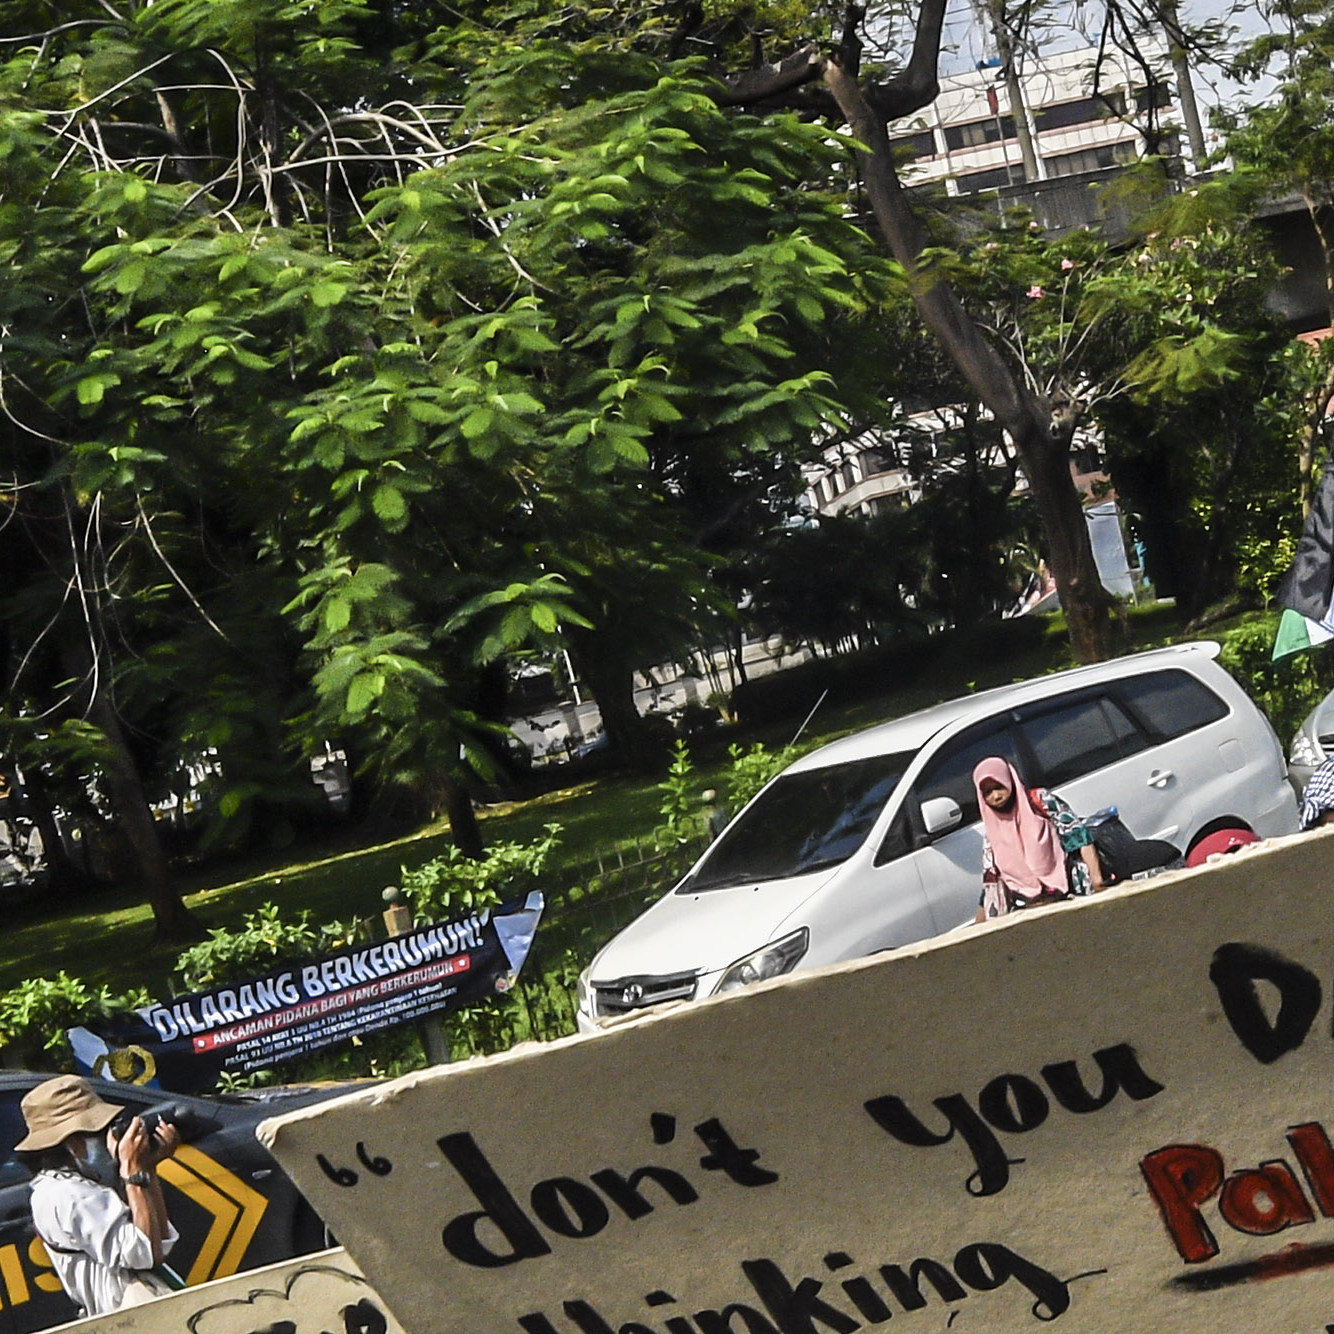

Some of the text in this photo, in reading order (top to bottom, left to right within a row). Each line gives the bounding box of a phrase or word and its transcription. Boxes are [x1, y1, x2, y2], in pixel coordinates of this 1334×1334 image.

[152, 915, 484, 1043] DILARANG BERKERUMUN!
[211, 961, 454, 1045] ANCAMAN PIDANA BAGI YANG BERKERUMUN
[864, 1040, 1165, 1197] you
